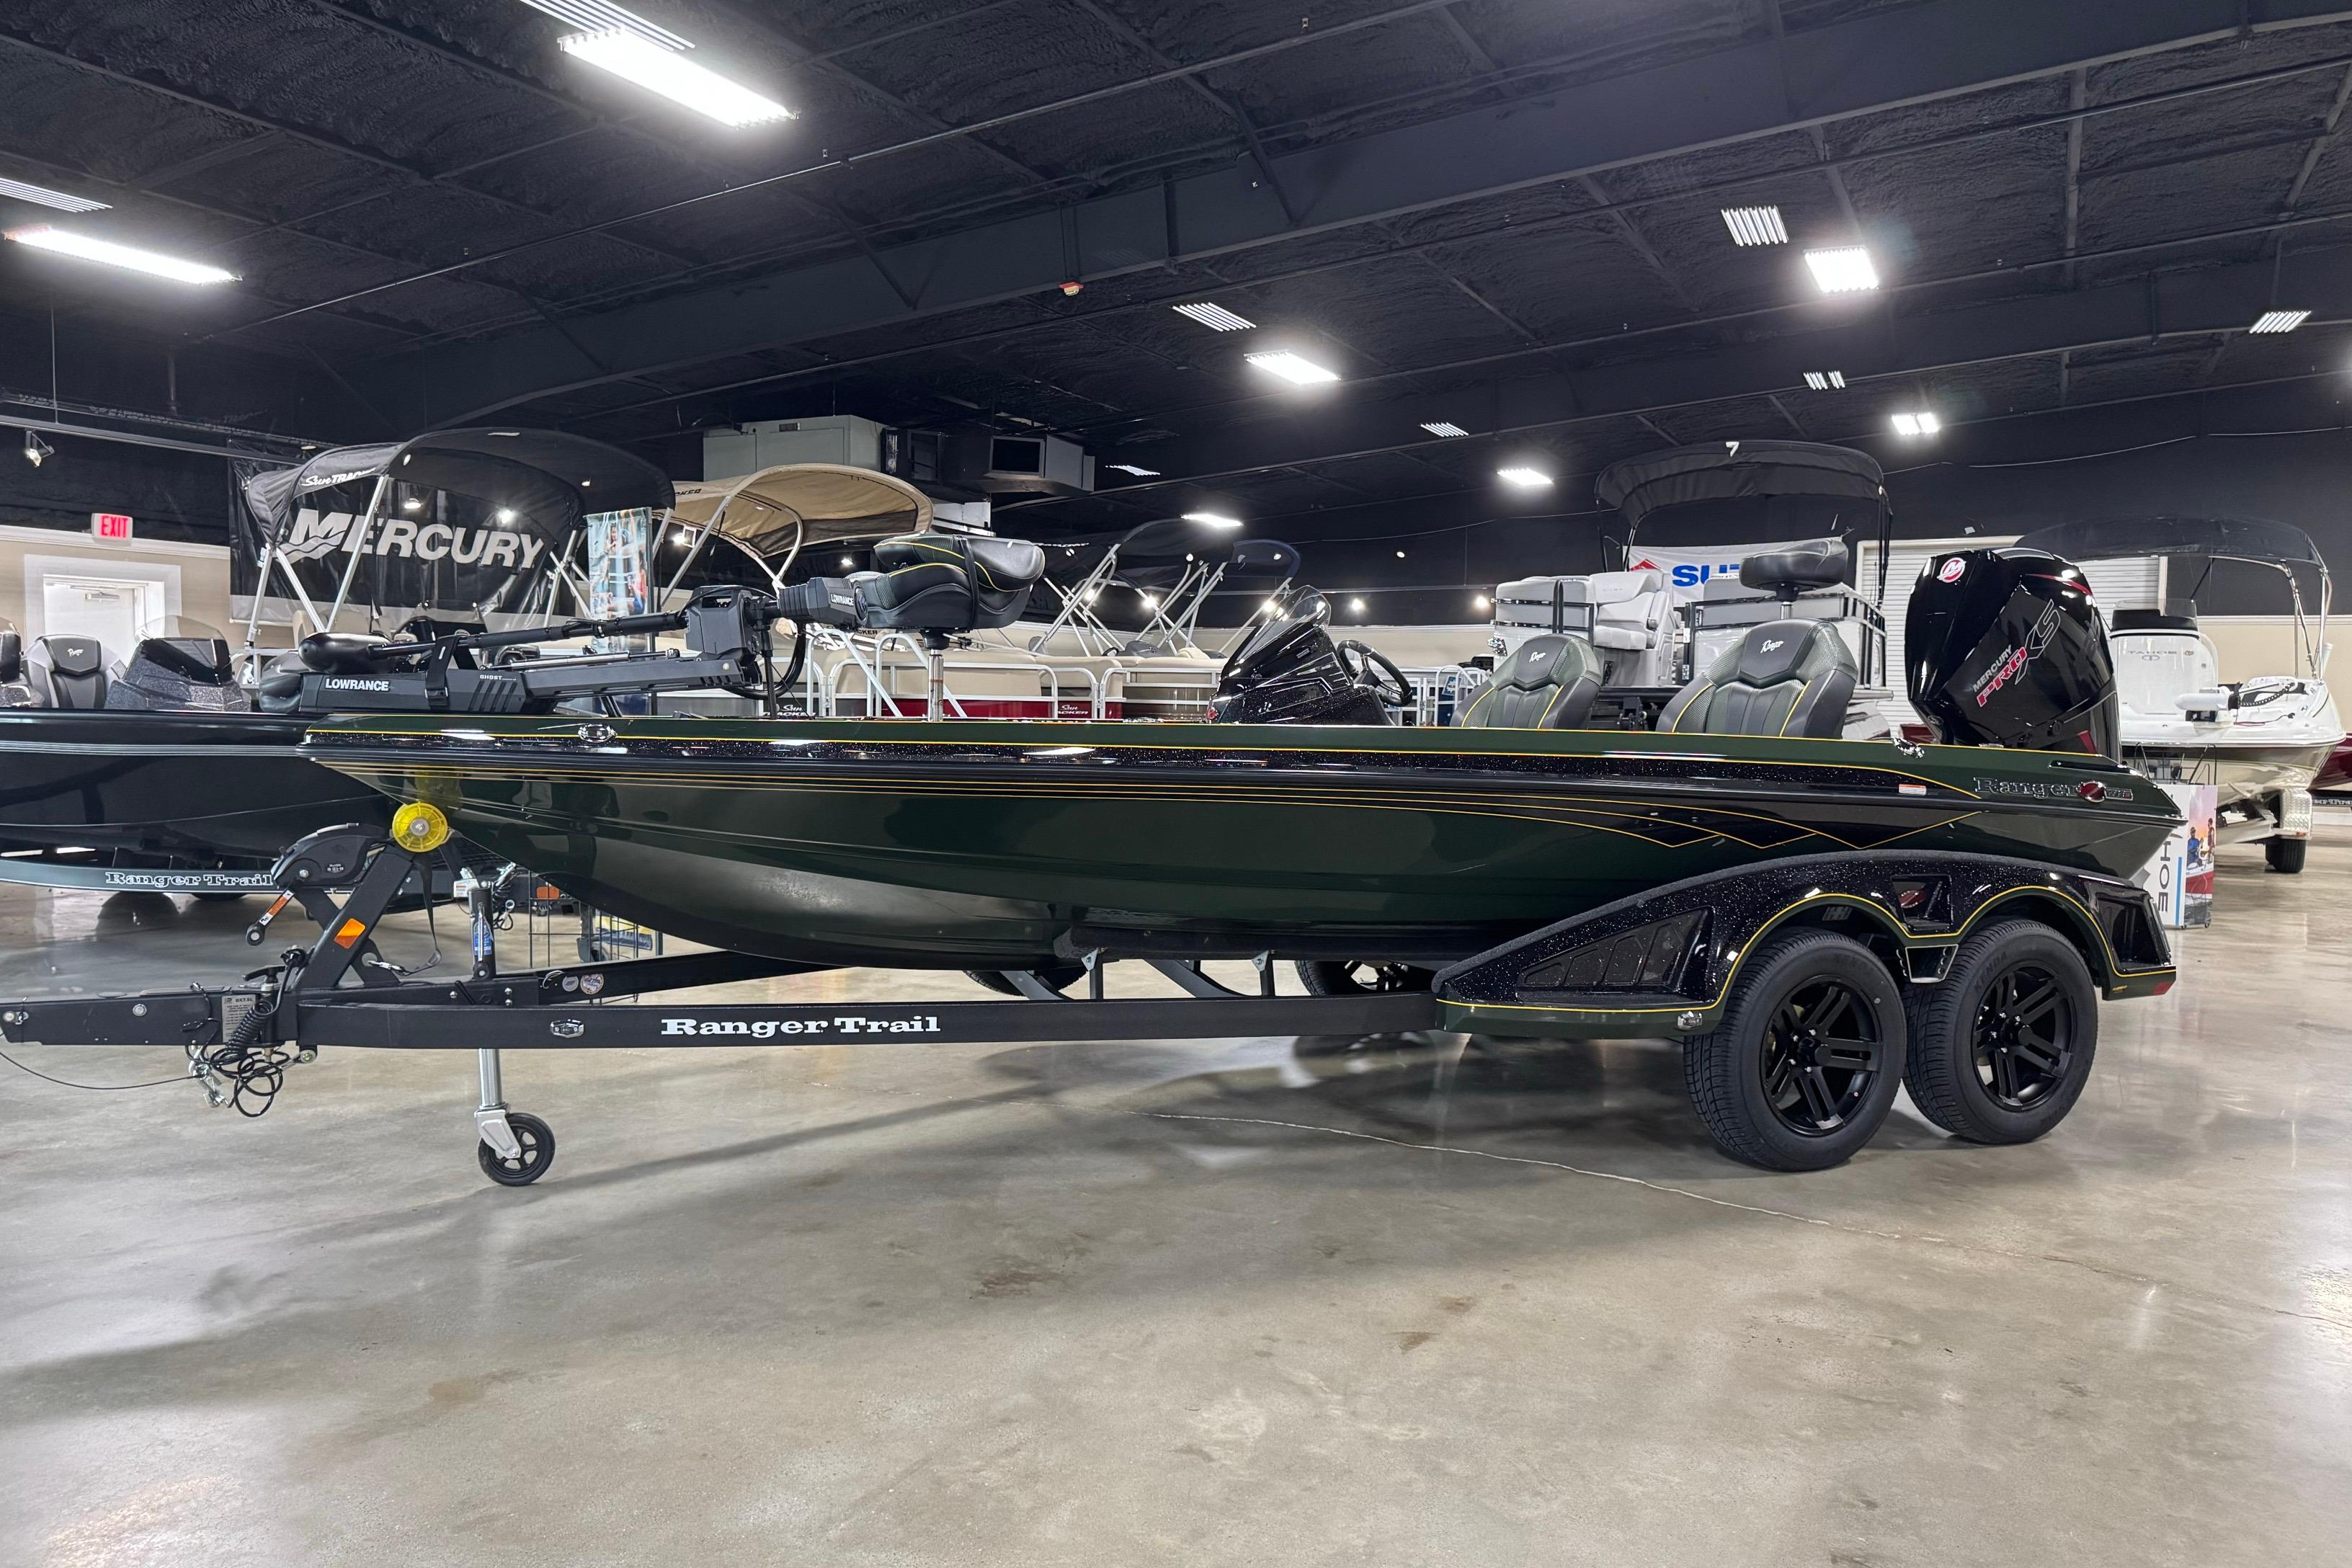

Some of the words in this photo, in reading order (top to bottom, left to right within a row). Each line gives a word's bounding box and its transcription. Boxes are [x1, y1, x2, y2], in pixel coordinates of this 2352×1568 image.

[101, 515, 128, 538] EXIT
[276, 508, 544, 569] MERCURY
[830, 594, 855, 606] LOWRANCE
[1972, 644, 2013, 692] MERCURY
[1977, 646, 2028, 708] PRO
[326, 678, 390, 692] LOWRANCE
[1973, 777, 2079, 799] Ranger
[105, 871, 201, 887] Ranger
[203, 874, 274, 886] Trail
[661, 1018, 828, 1038] Ranger
[834, 1015, 940, 1033] Trail
